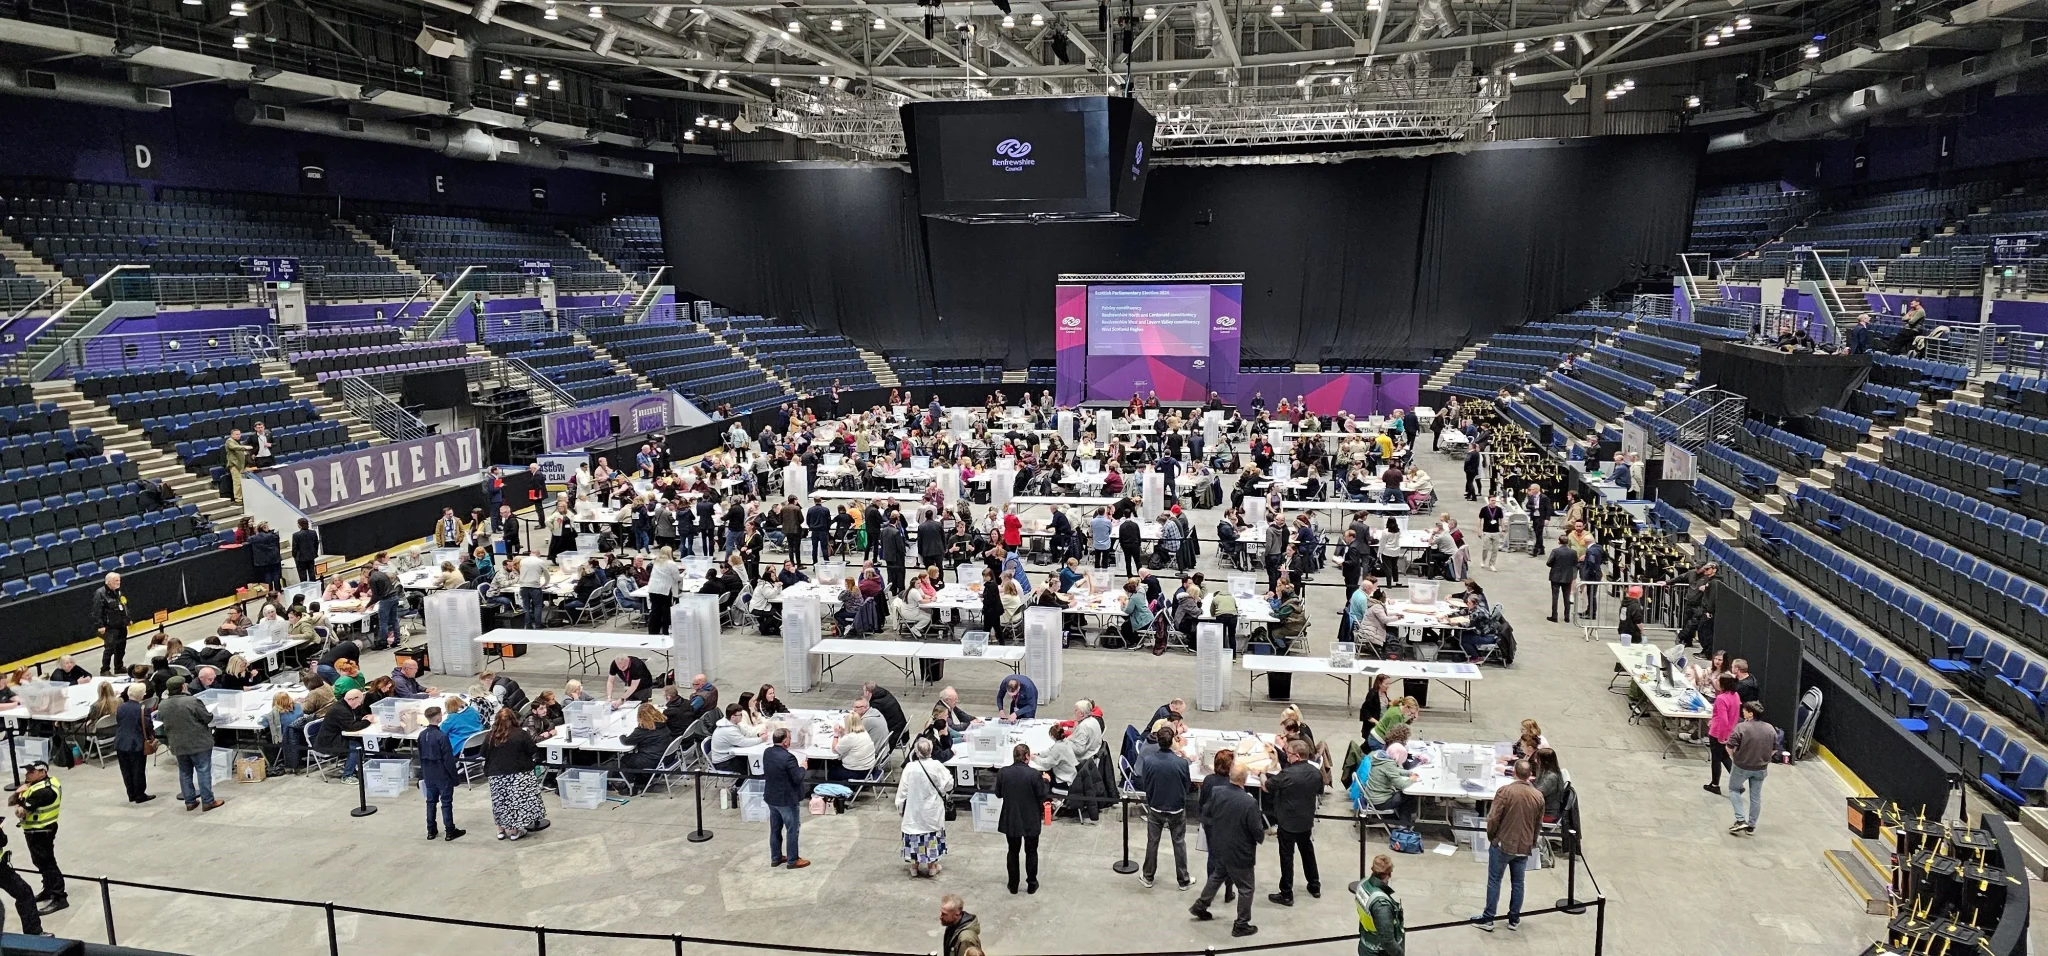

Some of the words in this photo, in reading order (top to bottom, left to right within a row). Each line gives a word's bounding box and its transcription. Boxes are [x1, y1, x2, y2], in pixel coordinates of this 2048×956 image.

[136, 144, 151, 169] D
[992, 158, 1036, 166] Renfrewshire
[435, 175, 444, 193] E
[601, 192, 607, 206] F
[555, 408, 612, 449] ARENA
[548, 473, 566, 481] CLAN
[362, 619, 370, 627] 10
[1411, 628, 1422, 636] 18
[270, 657, 275, 666] 9
[367, 740, 375, 750] 6
[551, 750, 558, 761] 5
[753, 759, 761, 769] 4
[961, 769, 970, 780] 3
